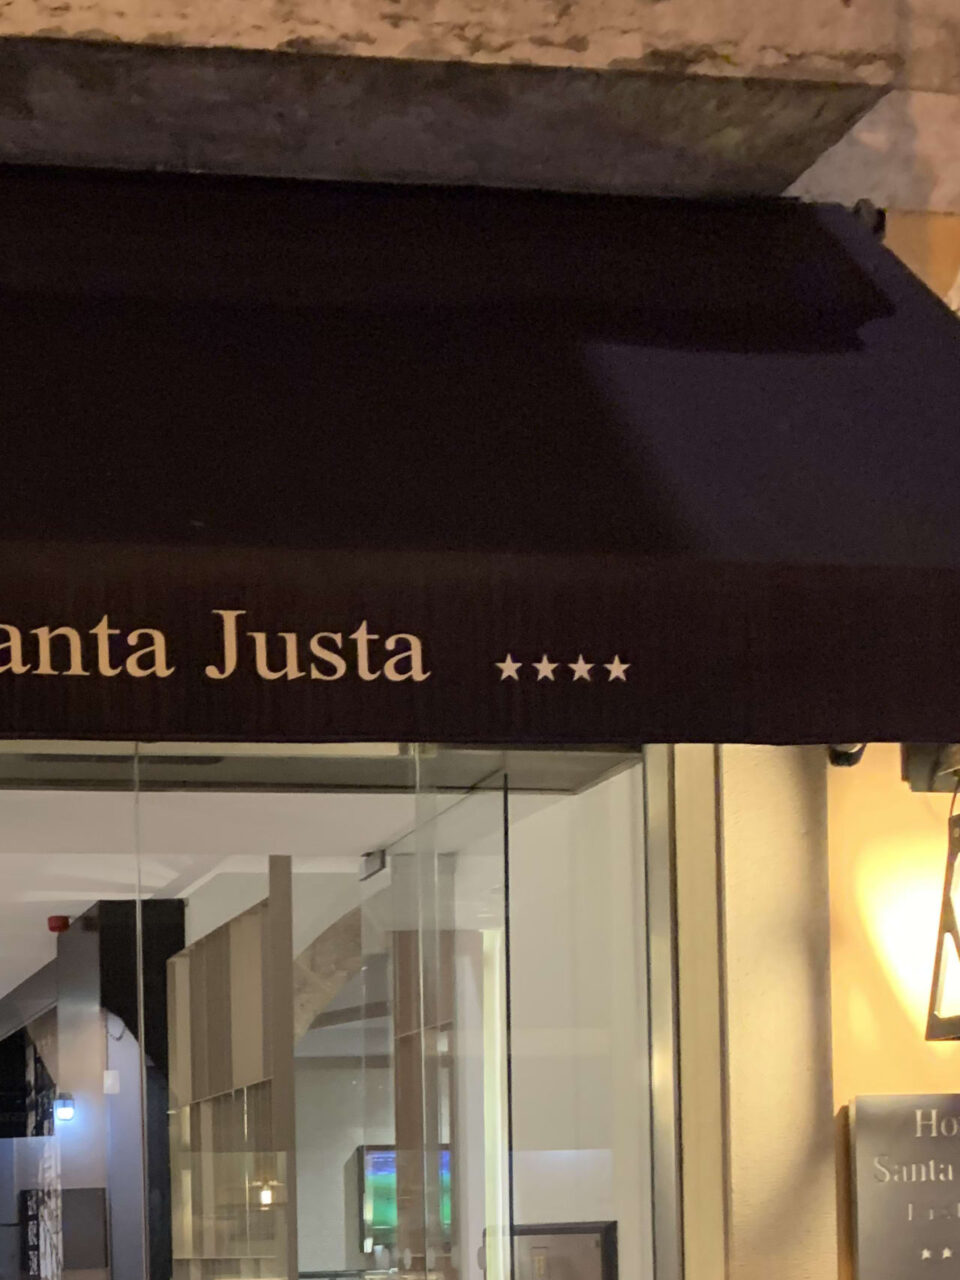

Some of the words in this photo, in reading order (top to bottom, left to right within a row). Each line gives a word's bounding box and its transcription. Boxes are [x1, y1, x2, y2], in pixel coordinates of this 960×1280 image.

[205, 609, 432, 683] Justa
[914, 1108, 960, 1137] Ho
[874, 1153, 953, 1183] Santa
